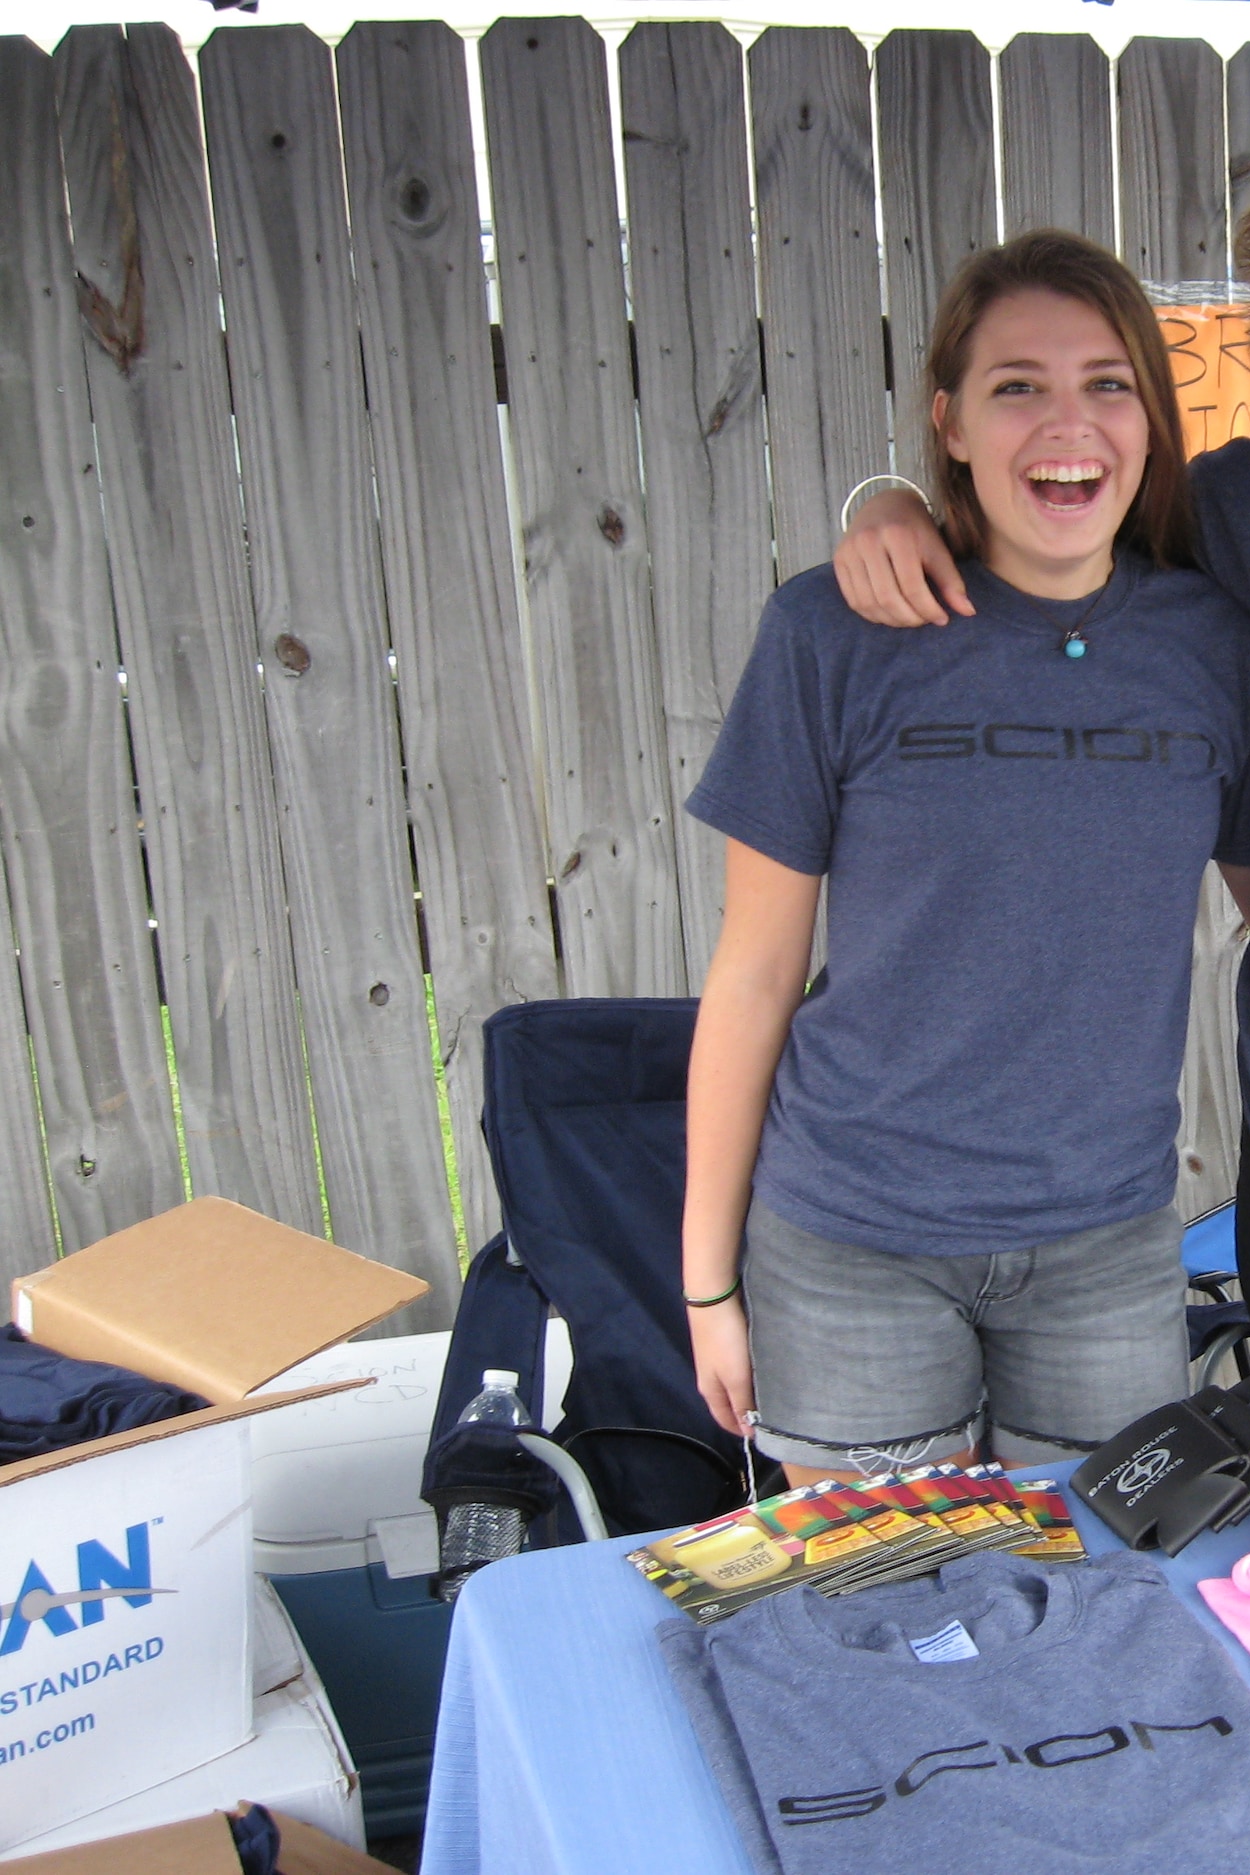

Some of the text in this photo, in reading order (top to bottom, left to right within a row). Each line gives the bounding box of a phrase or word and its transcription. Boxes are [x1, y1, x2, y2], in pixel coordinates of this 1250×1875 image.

[898, 723, 1216, 769] SCION
[1087, 1424, 1179, 1498] BATON ROUGE
[1125, 1457, 1185, 1508] DEALERS
[0, 1635, 165, 1716] STANDARD
[777, 1715, 1234, 1826] SCION
